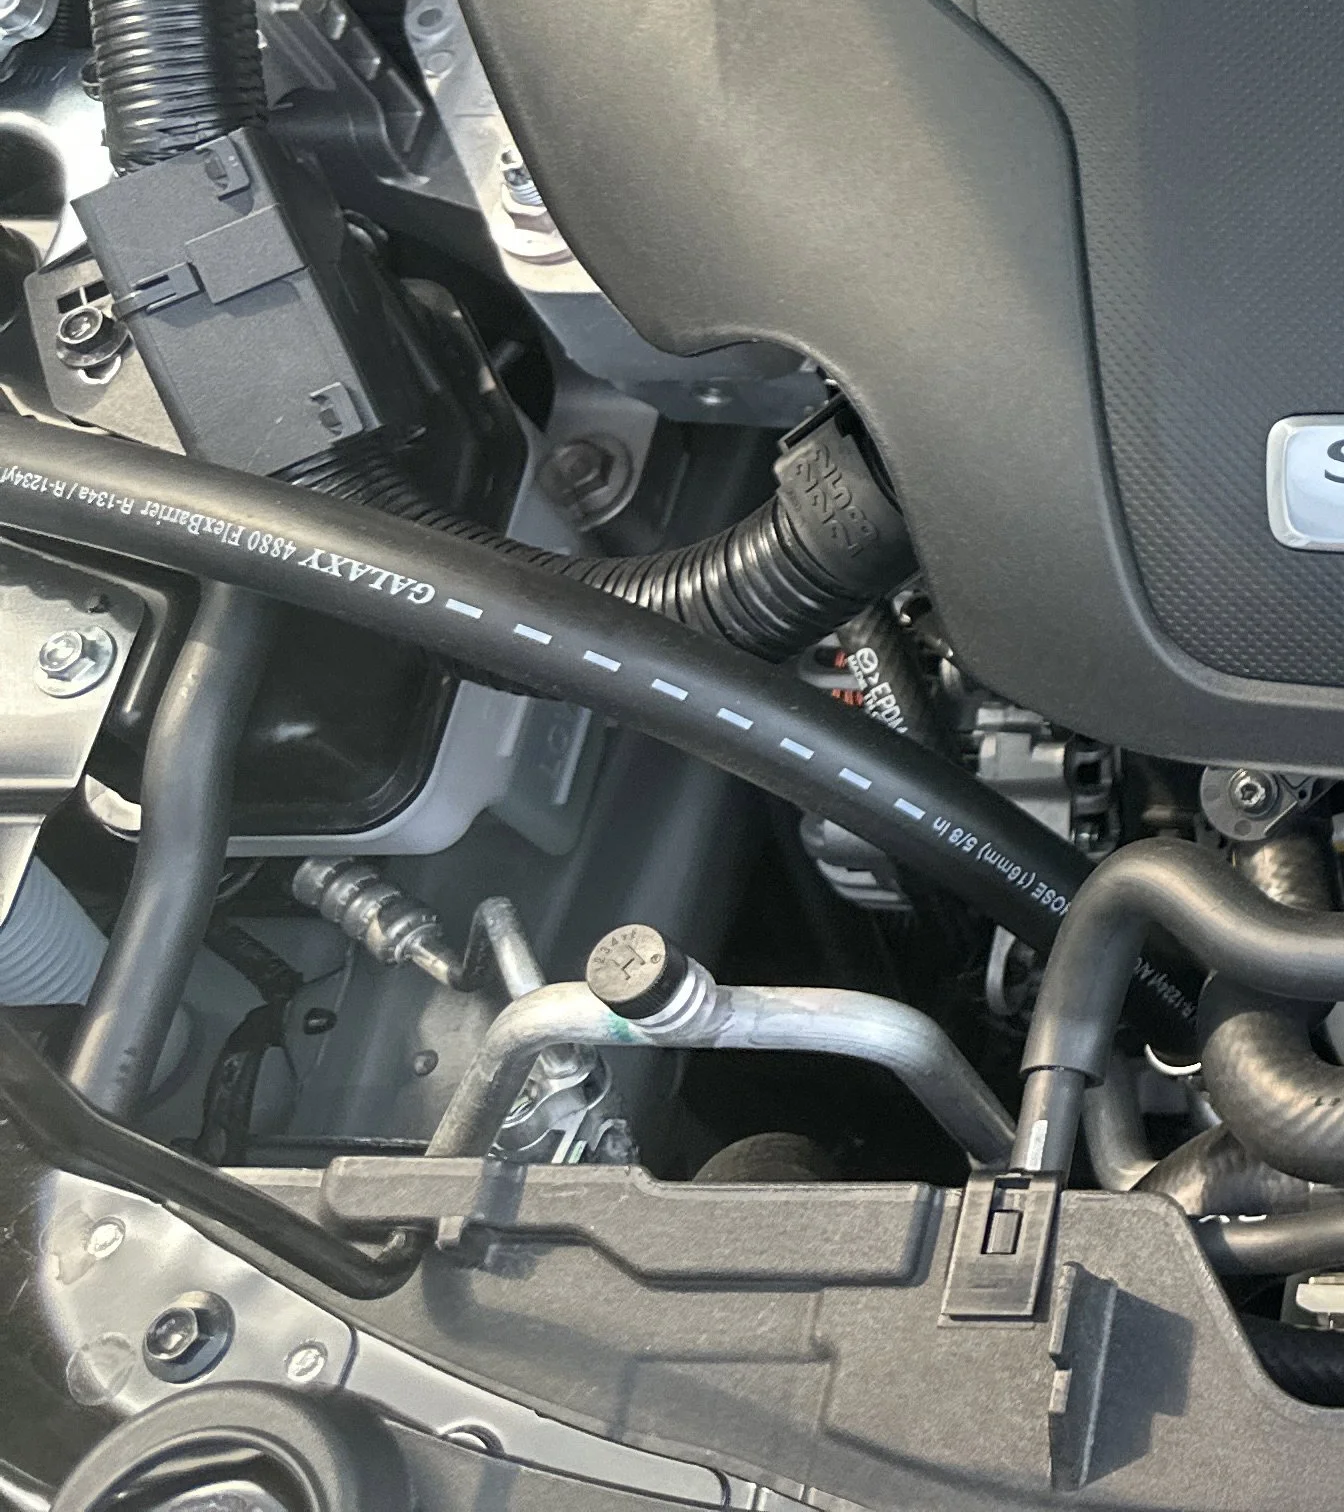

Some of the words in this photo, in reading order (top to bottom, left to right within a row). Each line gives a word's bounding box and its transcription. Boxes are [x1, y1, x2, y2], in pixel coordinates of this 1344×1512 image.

[78, 486, 135, 515] R-134a
[140, 500, 246, 547] FlexBarrier
[247, 530, 297, 561] 4880
[298, 548, 436, 605] GALAXY
[948, 827, 978, 852] 5/8
[976, 841, 1036, 889] (16mm)
